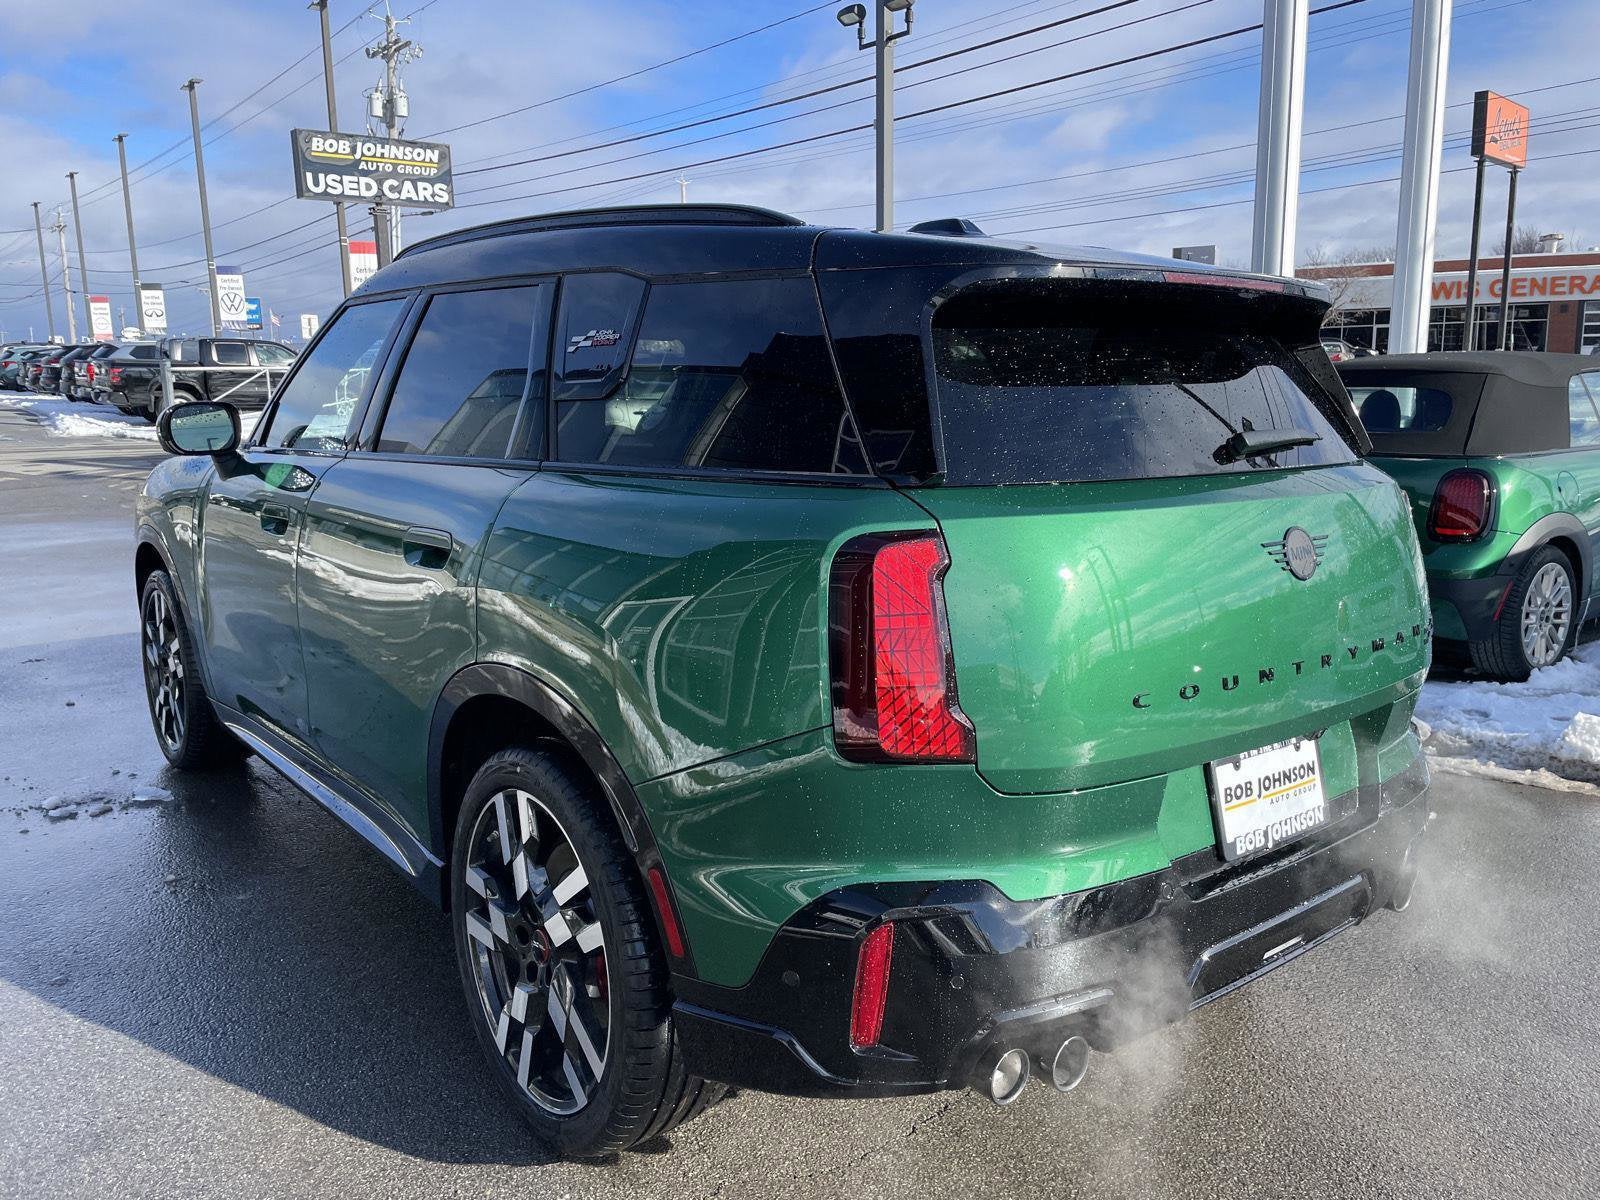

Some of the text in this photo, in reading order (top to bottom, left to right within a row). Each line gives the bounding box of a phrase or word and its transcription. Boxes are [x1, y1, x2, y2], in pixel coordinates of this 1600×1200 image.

[311, 137, 440, 163] BOB JOHNSON
[358, 161, 438, 177] AUTO GROUP
[305, 172, 450, 203] USED CARS
[1432, 275, 1600, 300] WIS GENERA
[1132, 624, 1421, 709] COUNTRYMAN
[1223, 760, 1316, 805] BOB JOHNSON
[1270, 783, 1317, 805] AUTO GROUP
[1235, 804, 1325, 856] BOB JOHNSON
